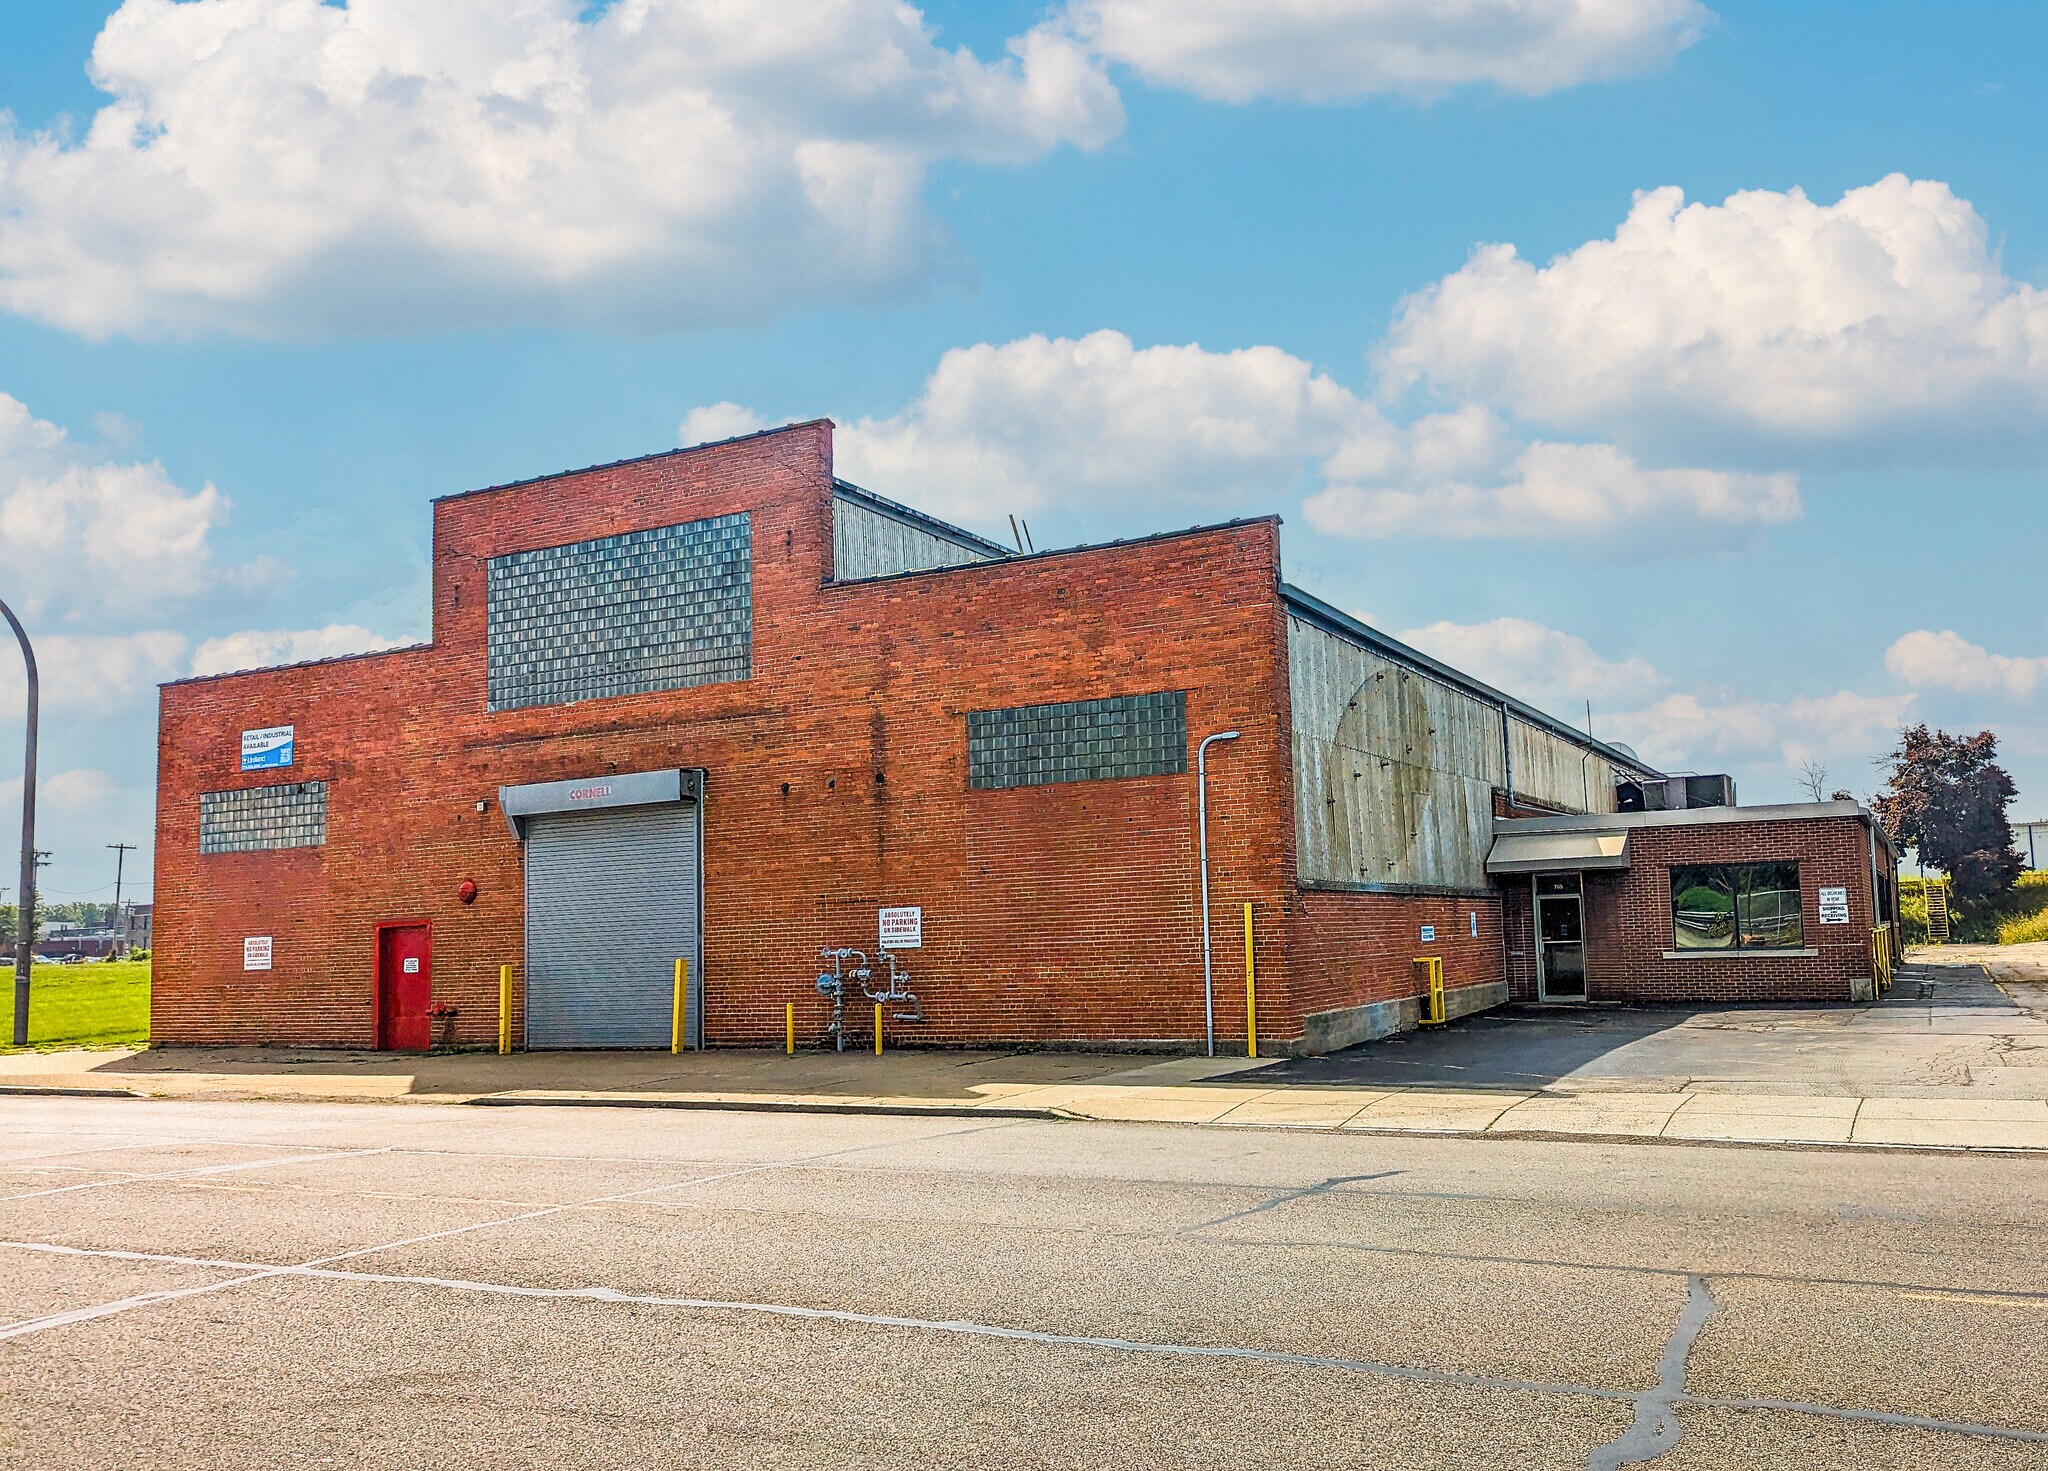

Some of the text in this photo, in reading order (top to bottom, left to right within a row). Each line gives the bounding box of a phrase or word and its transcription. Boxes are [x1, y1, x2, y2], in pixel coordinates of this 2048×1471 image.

[243, 734, 259, 742] RETAIL
[263, 730, 292, 740] INDUSTRIAL
[243, 741, 269, 750] AVAILABLE
[569, 786, 611, 800] CORNELL
[882, 918, 918, 927] NO PARKING
